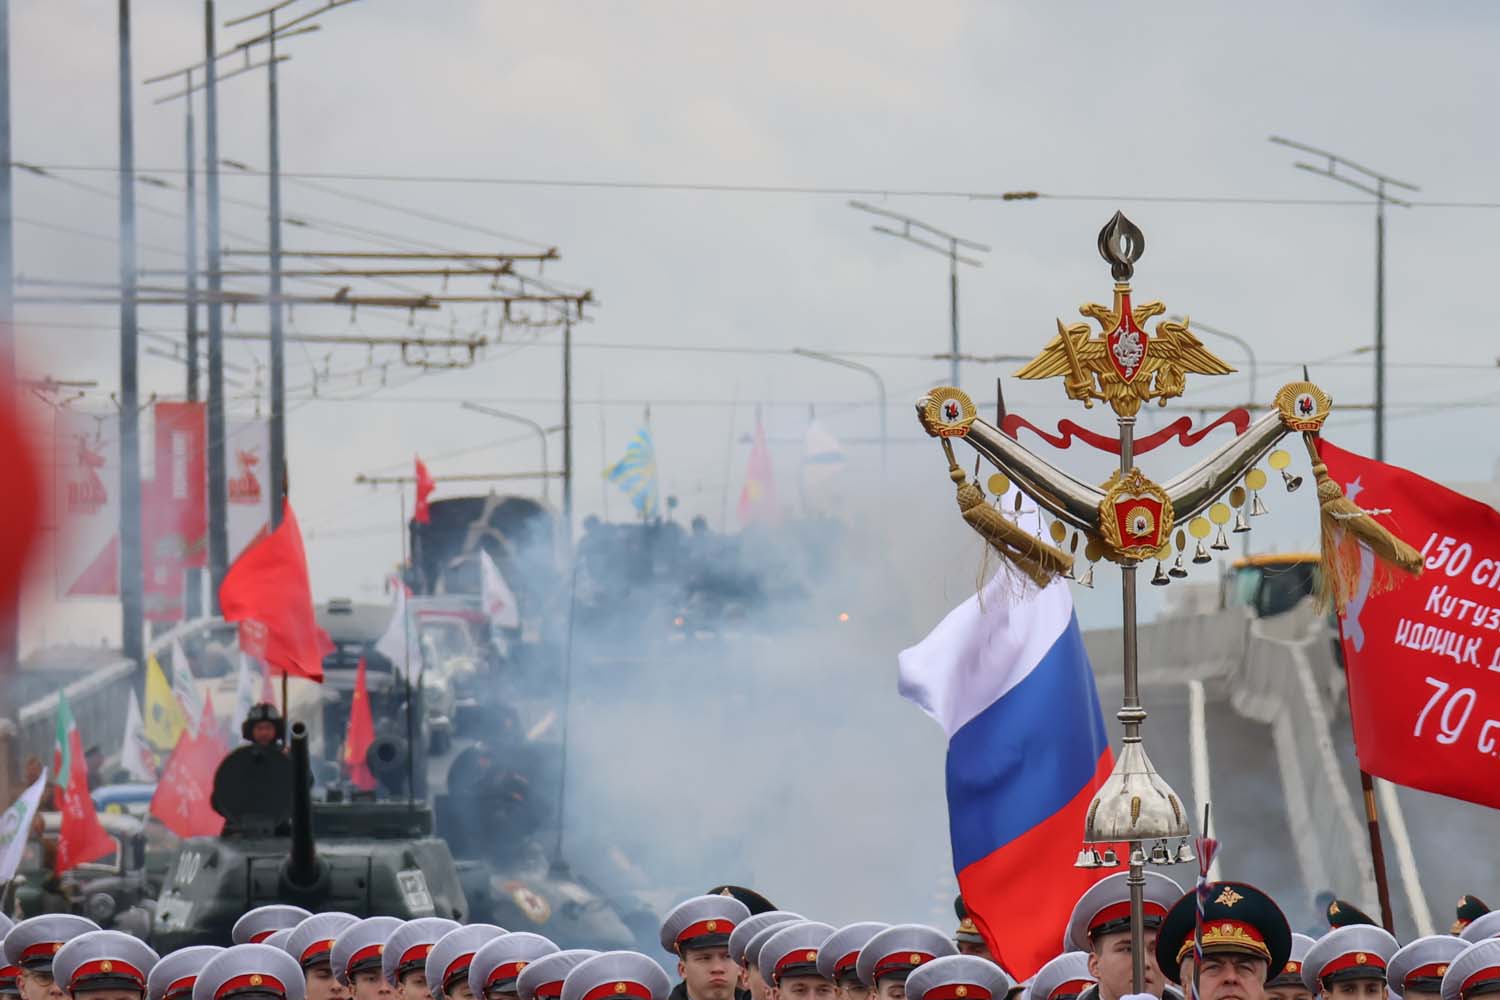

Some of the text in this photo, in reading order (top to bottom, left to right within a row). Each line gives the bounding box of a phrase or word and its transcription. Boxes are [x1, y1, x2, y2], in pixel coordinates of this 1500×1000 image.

[1420, 532, 1472, 577] 150
[1394, 618, 1482, 669] ИДРИЦК.
[1413, 676, 1477, 744] 79
